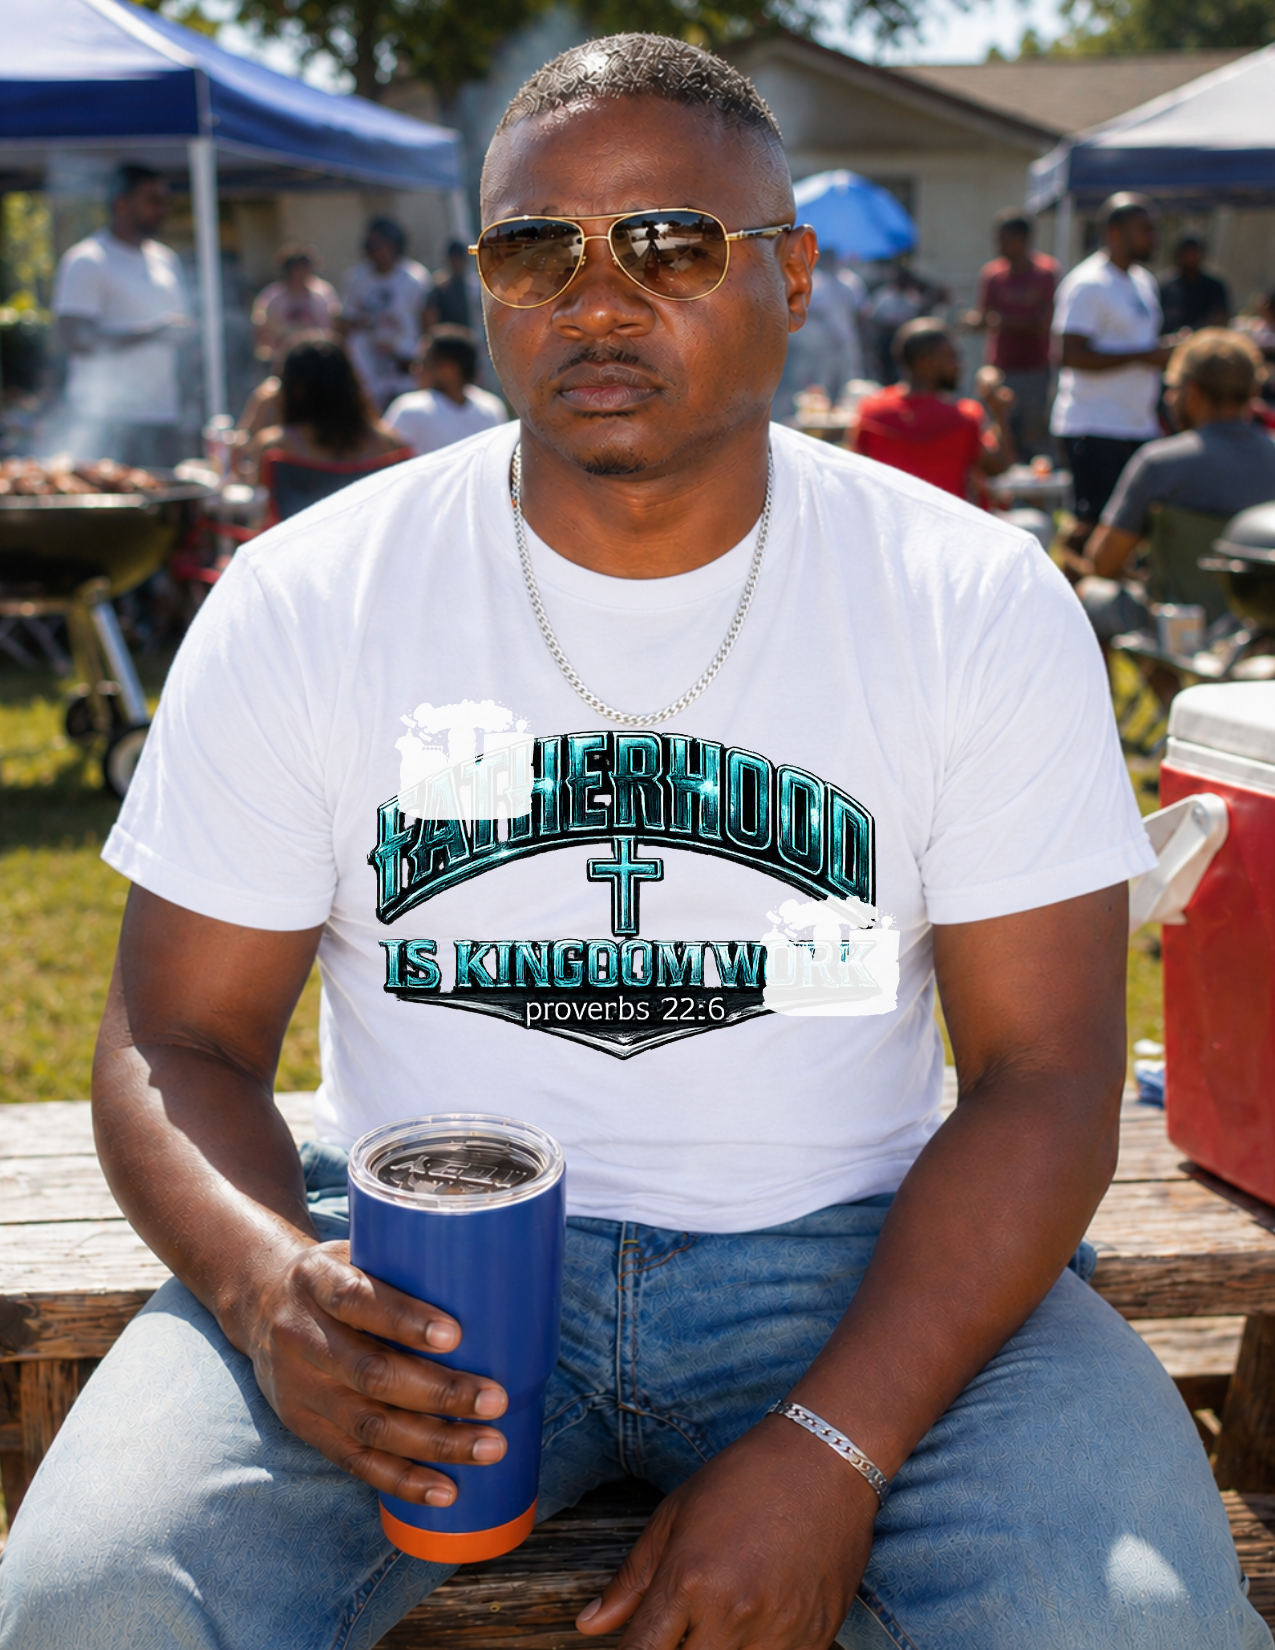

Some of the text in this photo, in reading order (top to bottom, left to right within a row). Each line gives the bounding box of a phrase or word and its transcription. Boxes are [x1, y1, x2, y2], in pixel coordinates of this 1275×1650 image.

[371, 731, 876, 914] FATHERHOOD
[378, 939, 442, 991] IS
[525, 995, 726, 1029] proverbs 22:6
